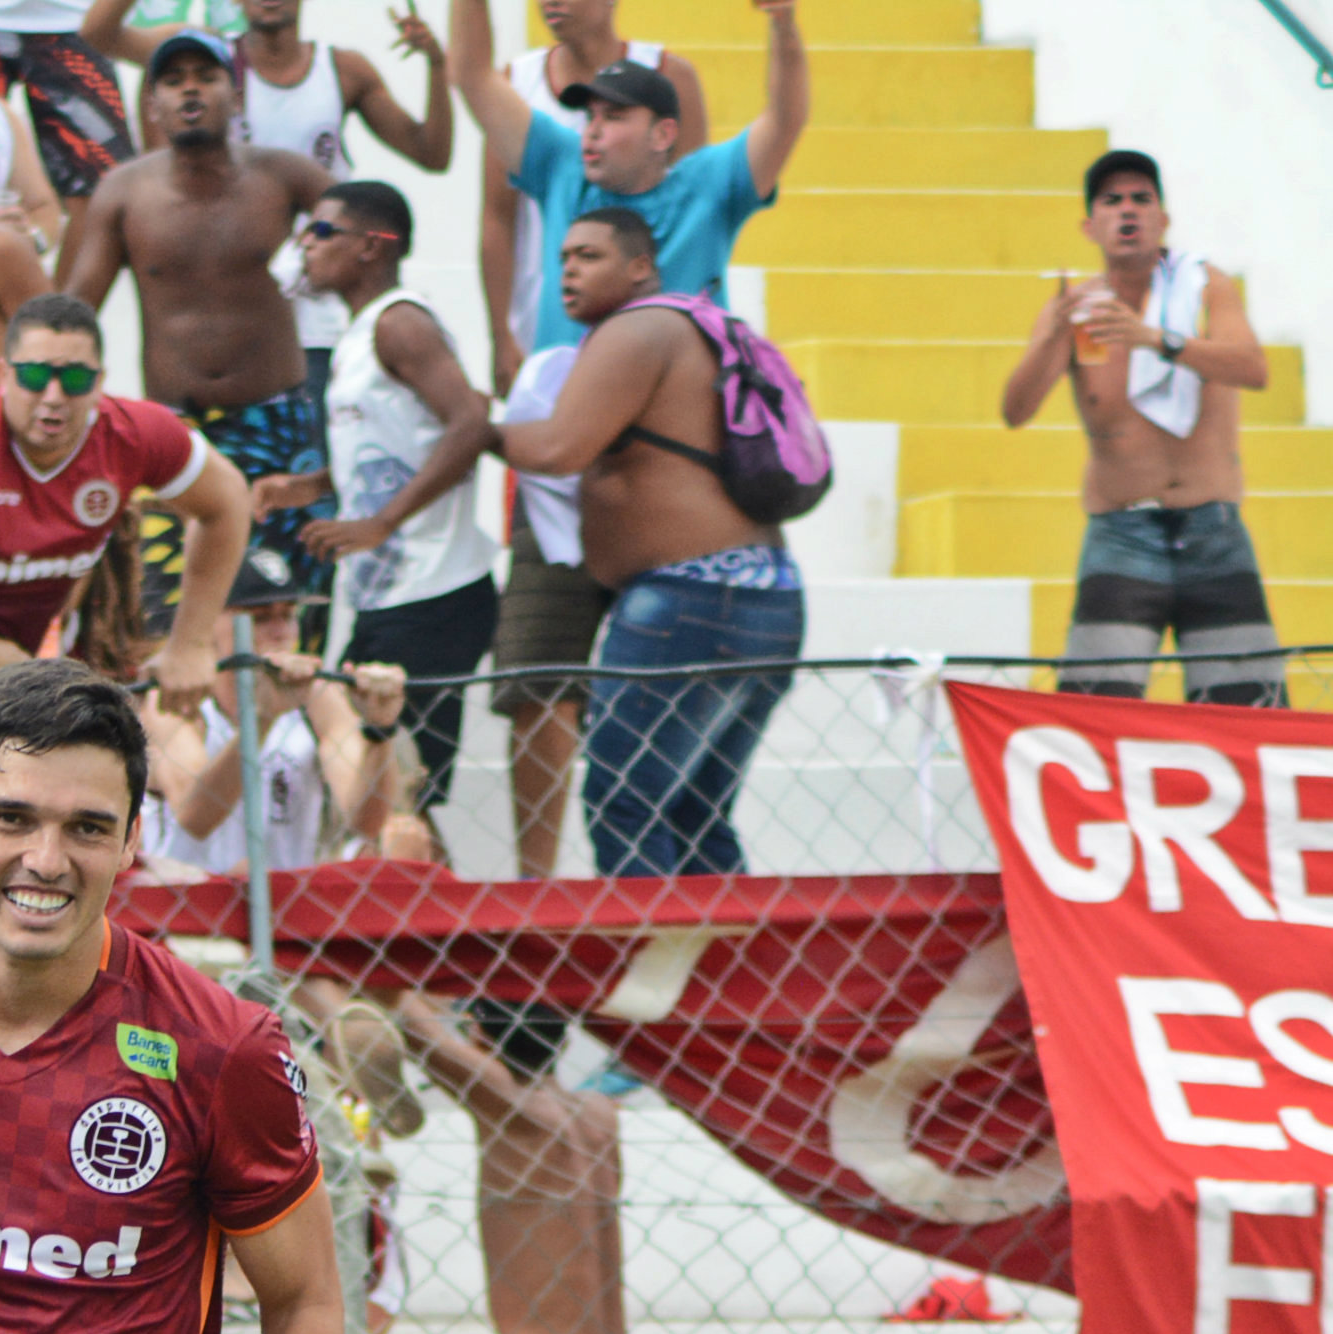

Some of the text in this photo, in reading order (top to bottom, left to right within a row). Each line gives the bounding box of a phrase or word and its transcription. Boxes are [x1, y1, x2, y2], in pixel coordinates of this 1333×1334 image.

[1002, 724, 1332, 926] GRE
[127, 1031, 170, 1054] Banes
[139, 1053, 169, 1070] card
